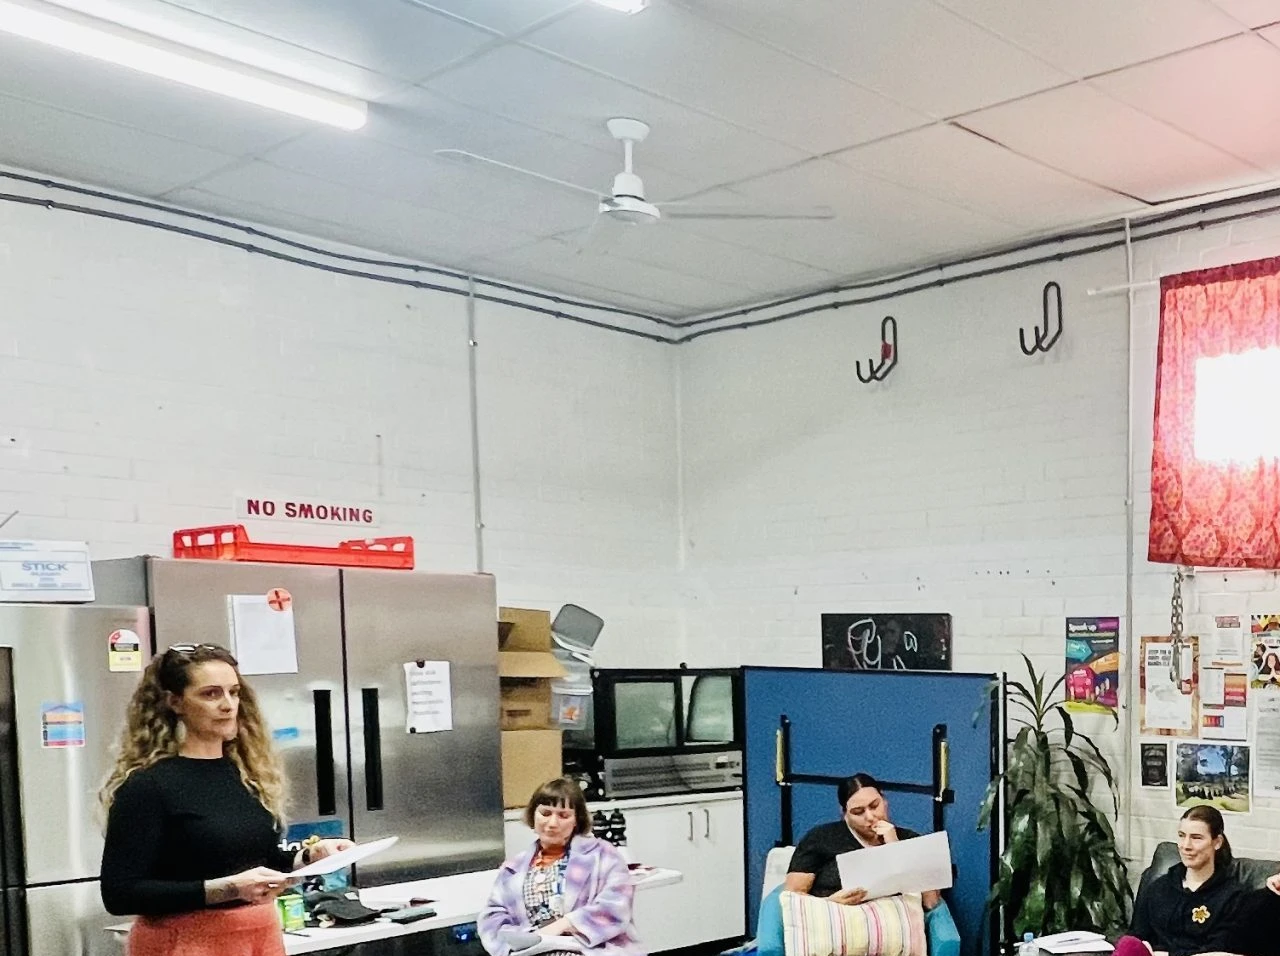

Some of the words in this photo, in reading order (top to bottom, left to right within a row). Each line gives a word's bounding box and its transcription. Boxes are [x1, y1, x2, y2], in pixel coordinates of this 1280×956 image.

[247, 499, 275, 517] NO
[285, 502, 373, 523] SMOKING
[22, 560, 68, 571] STICK
